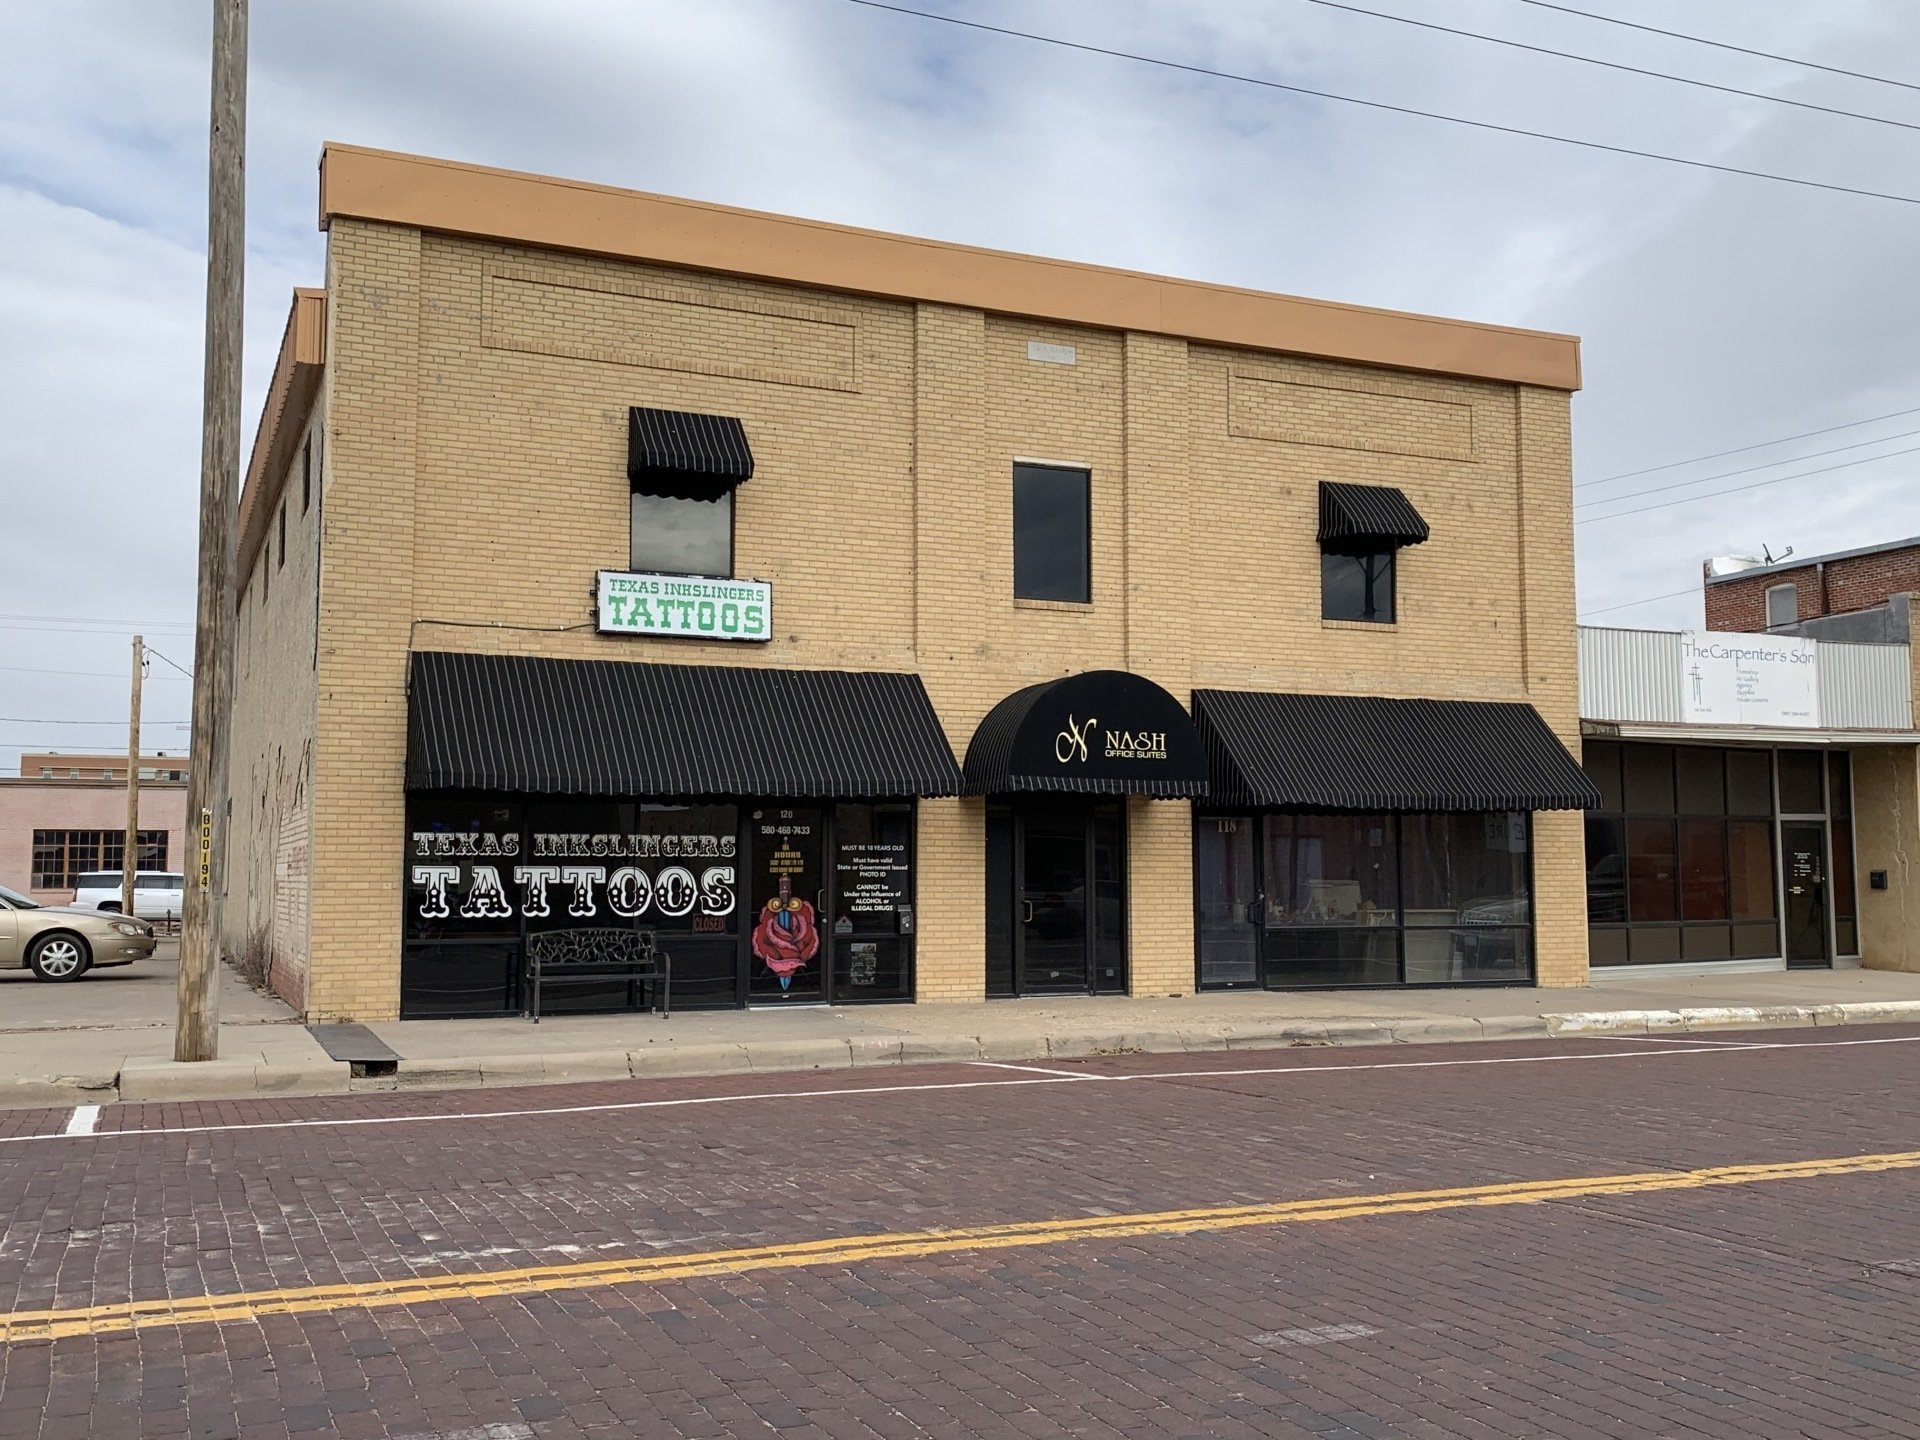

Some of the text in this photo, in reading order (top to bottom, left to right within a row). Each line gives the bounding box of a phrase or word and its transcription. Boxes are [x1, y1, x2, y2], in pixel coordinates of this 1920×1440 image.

[609, 578, 765, 602] TEXAS INKSLINGERS
[608, 594, 765, 635] TATTOOS
[1682, 639, 1815, 667] The Carpenter's Son
[1105, 730, 1167, 752] NASH
[1104, 750, 1167, 760] OFFICE SUITES
[780, 810, 793, 820] 120
[1217, 819, 1237, 833] 118
[412, 831, 737, 858] TEXAS INKSLINGERS
[411, 865, 737, 919] TATTOOS
[694, 916, 724, 932] CLOSED
